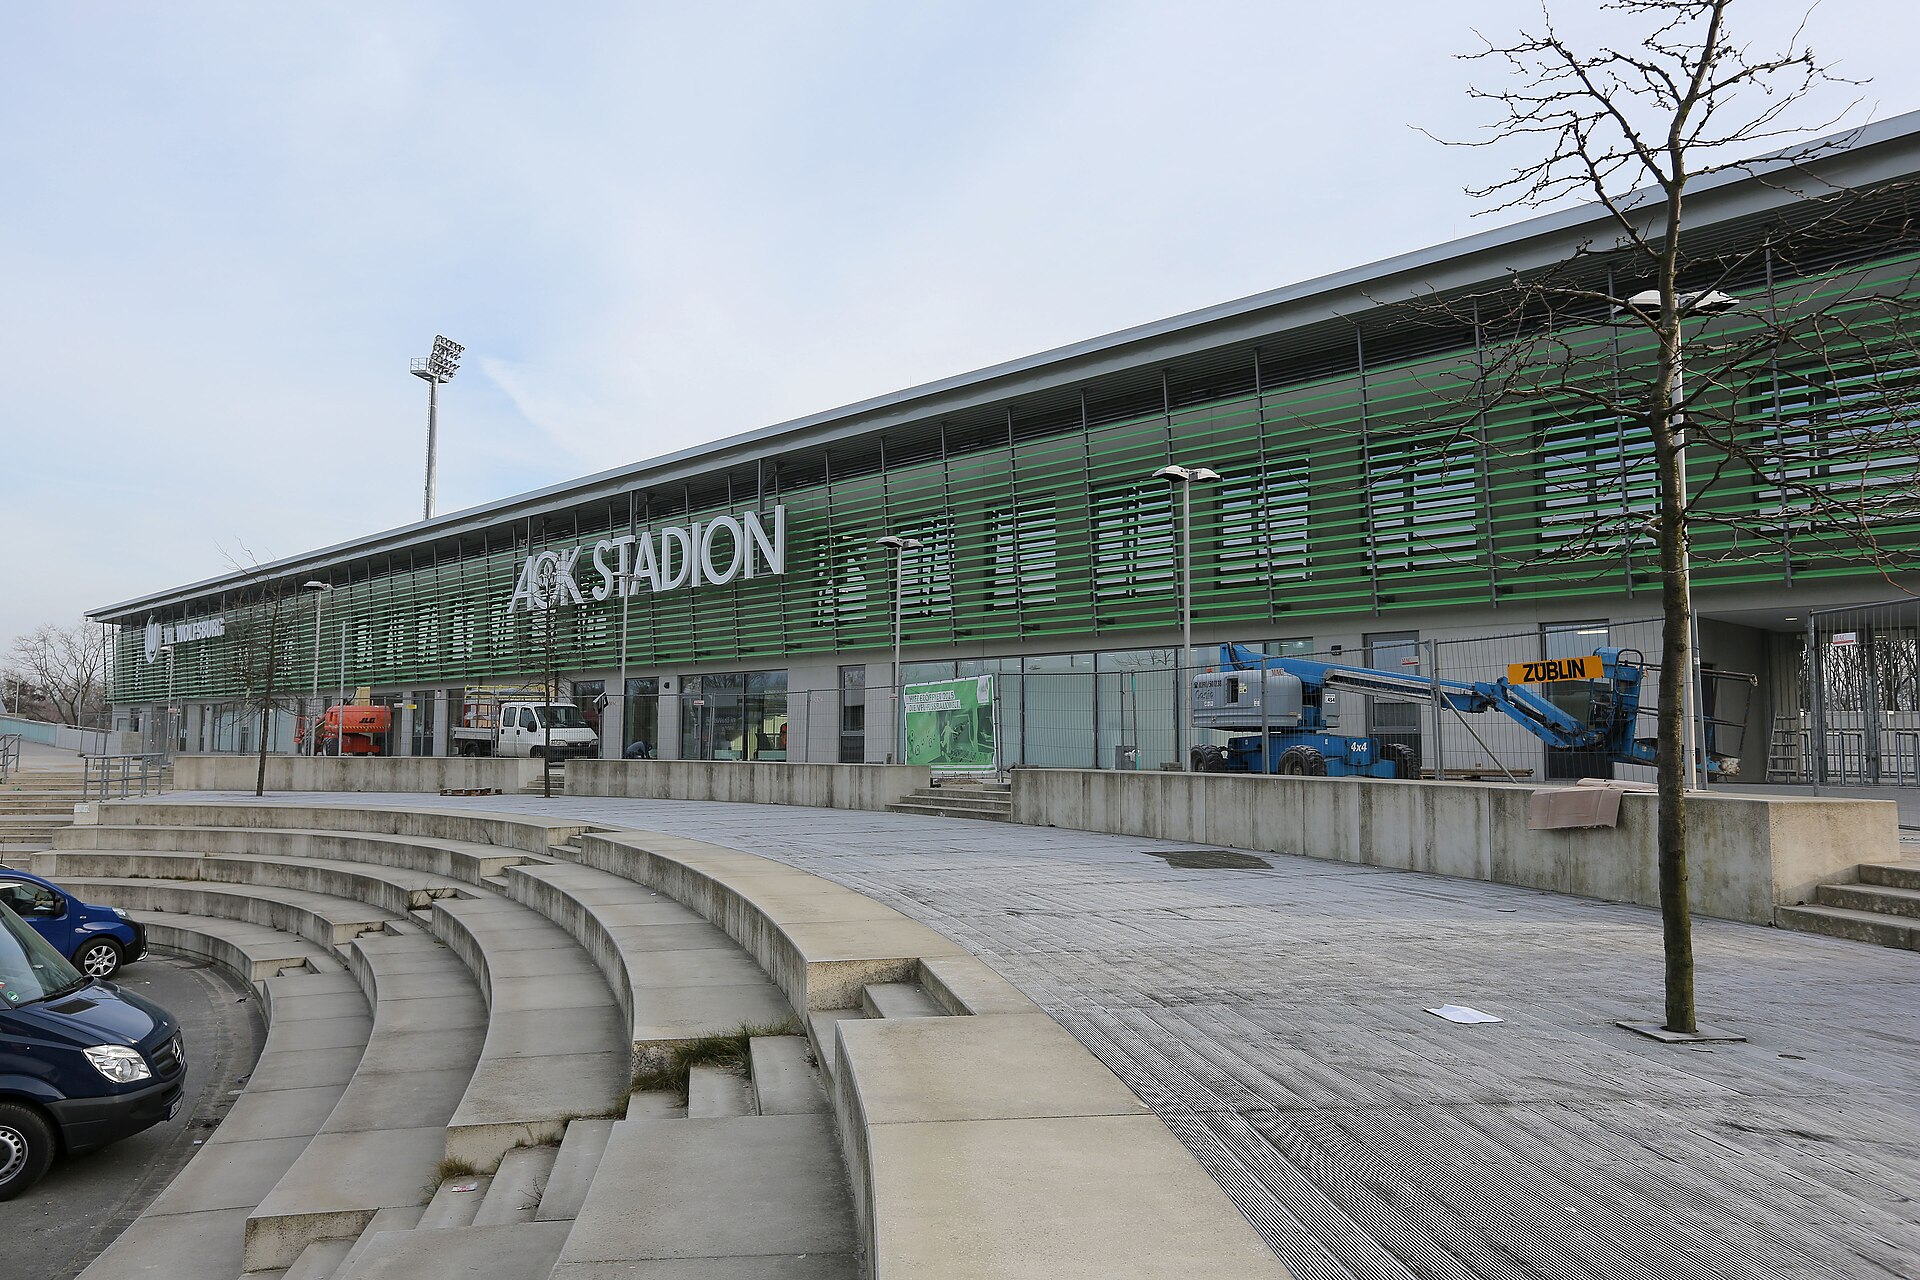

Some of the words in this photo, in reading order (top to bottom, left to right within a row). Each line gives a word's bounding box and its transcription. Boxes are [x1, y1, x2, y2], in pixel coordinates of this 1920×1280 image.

[507, 545, 584, 614] AOK
[592, 504, 787, 602] STADION
[176, 618, 226, 643] WOLFSBURG
[1522, 658, 1586, 682] ZÜBLIN
[943, 691, 955, 700] 2015
[1350, 741, 1368, 752] 4x4
